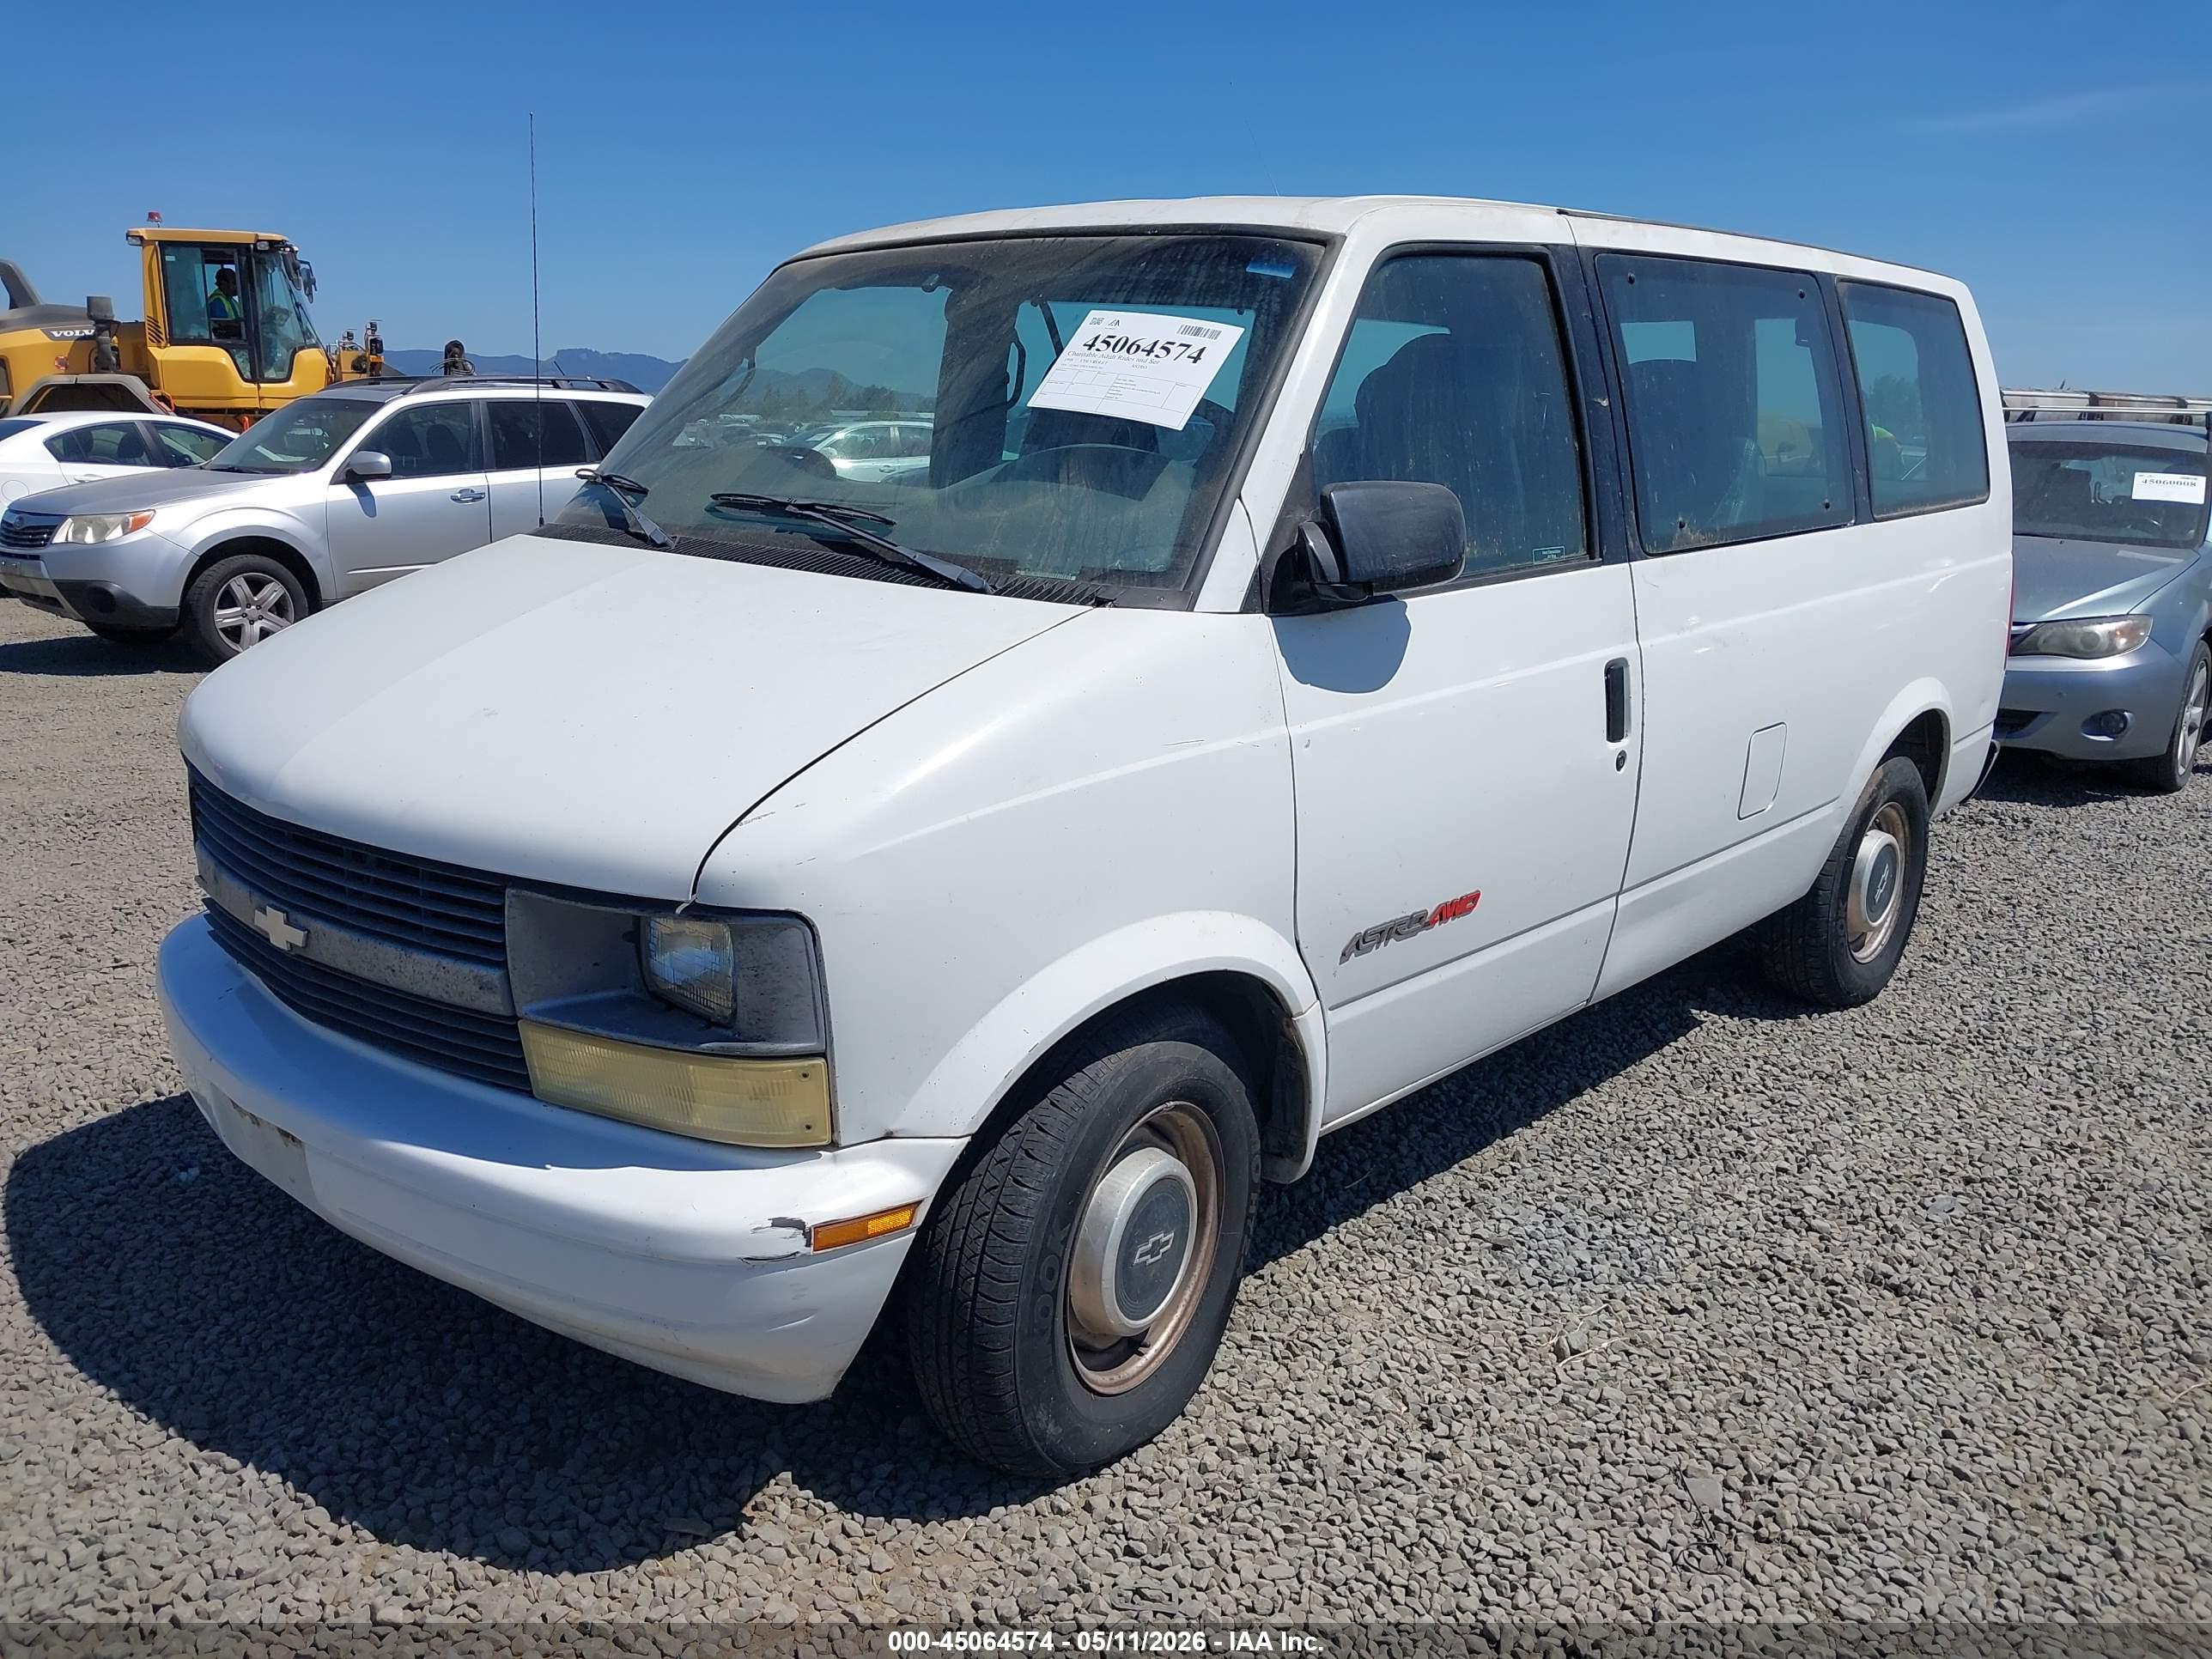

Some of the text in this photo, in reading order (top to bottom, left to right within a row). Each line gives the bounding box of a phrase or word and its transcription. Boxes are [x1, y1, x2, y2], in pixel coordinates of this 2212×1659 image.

[51, 329, 95, 337] VOLV
[1082, 332, 1208, 365] 45064574
[1339, 890, 1481, 965] ASTRO AWD
